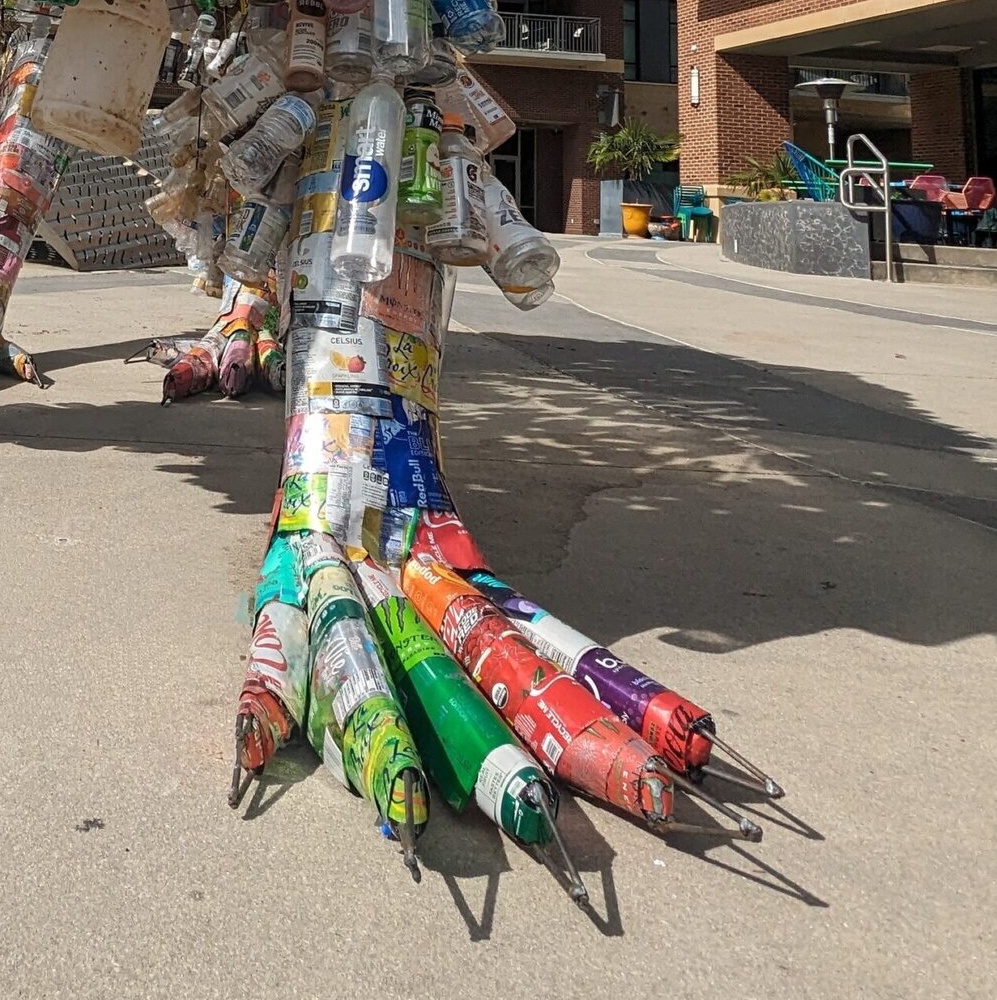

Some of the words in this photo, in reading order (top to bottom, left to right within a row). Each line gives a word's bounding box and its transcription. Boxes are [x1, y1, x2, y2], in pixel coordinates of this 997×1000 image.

[375, 128, 387, 158] water
[352, 125, 376, 192] smart
[330, 336, 363, 346] CELSIUS
[393, 331, 413, 360] La
[387, 360, 422, 383] roix
[409, 459, 422, 484] Bull
[416, 482, 428, 508] Red
[457, 606, 479, 628] CODE
[457, 614, 480, 642] RED
[395, 633, 436, 651] NSTER
[537, 699, 548, 715] ME
[545, 709, 573, 745] RECYCLE
